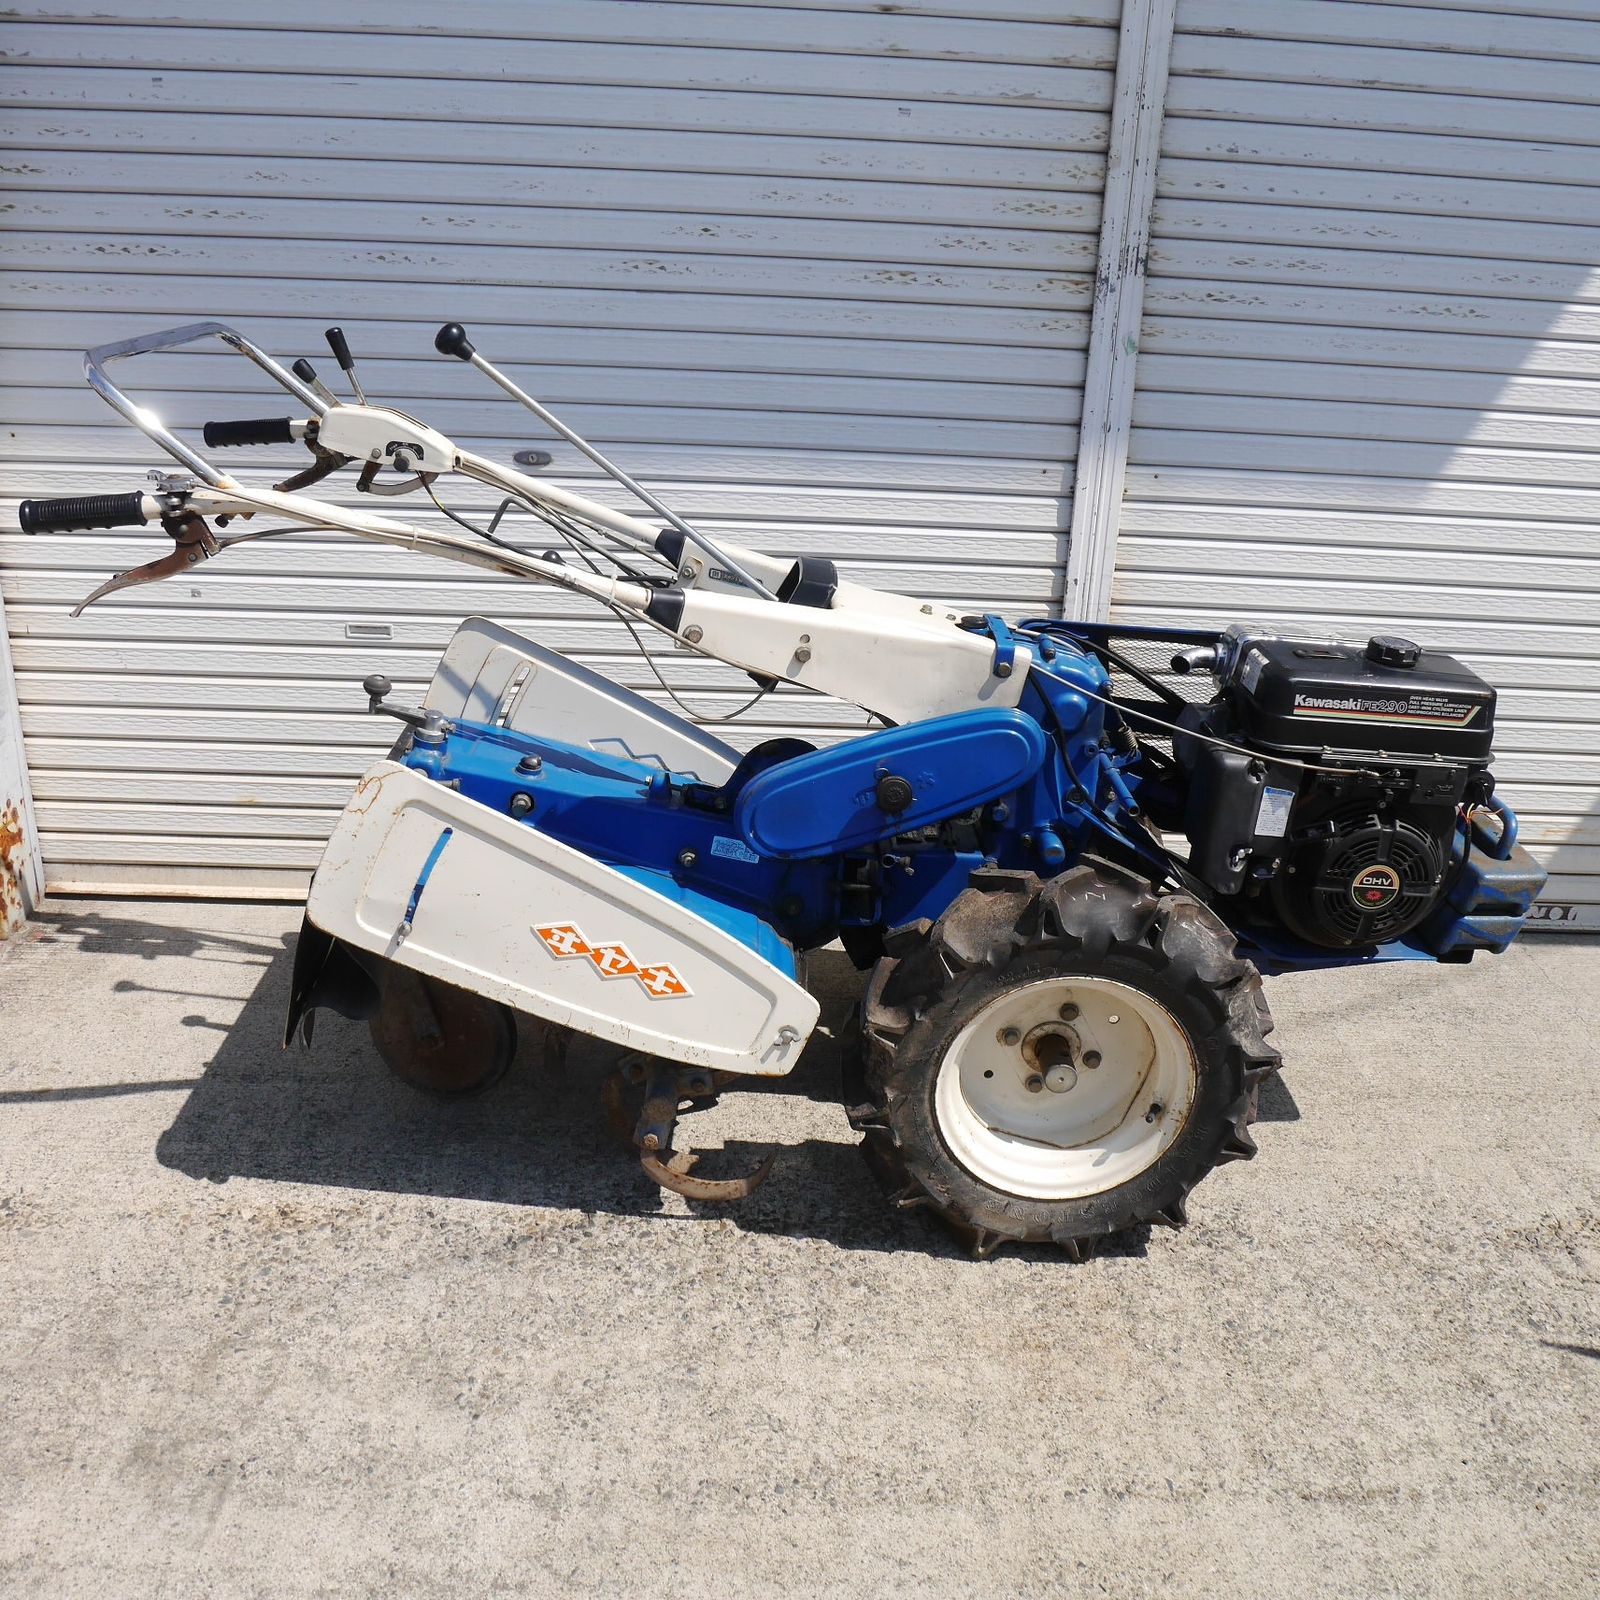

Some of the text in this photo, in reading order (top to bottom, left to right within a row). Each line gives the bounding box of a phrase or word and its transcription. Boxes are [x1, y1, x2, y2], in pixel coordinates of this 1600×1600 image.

[1294, 694, 1408, 714] Kawasaki FE290
[1362, 877, 1392, 885] OHV
